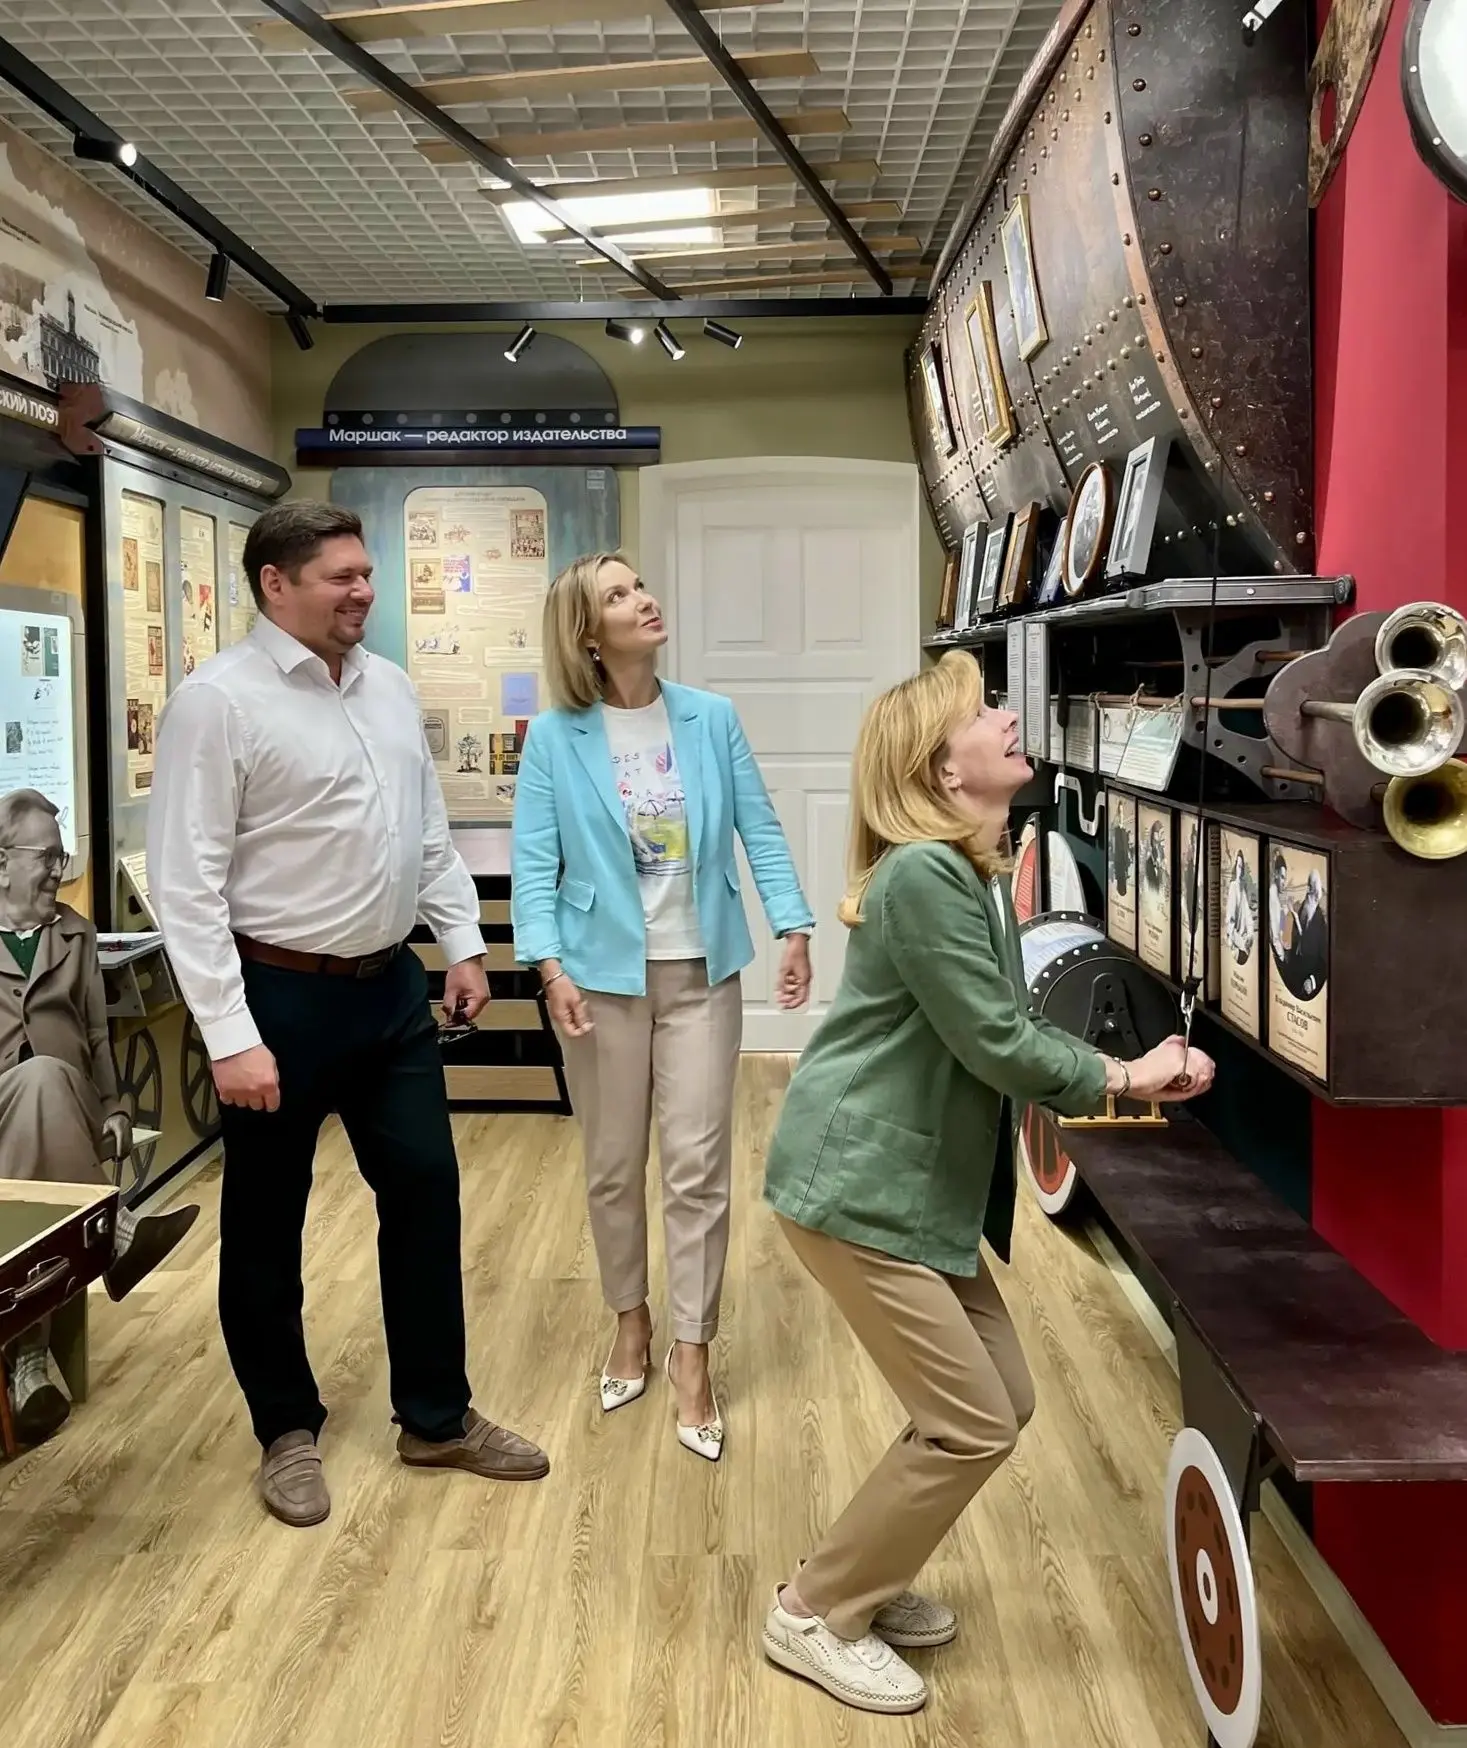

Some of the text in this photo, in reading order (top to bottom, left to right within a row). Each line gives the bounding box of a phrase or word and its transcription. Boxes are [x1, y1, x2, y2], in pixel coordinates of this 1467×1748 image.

[29, 400, 59, 426] ПОЭТ
[329, 428, 401, 444] Маршак
[426, 429, 508, 444] редактор
[512, 428, 627, 442] издательства
